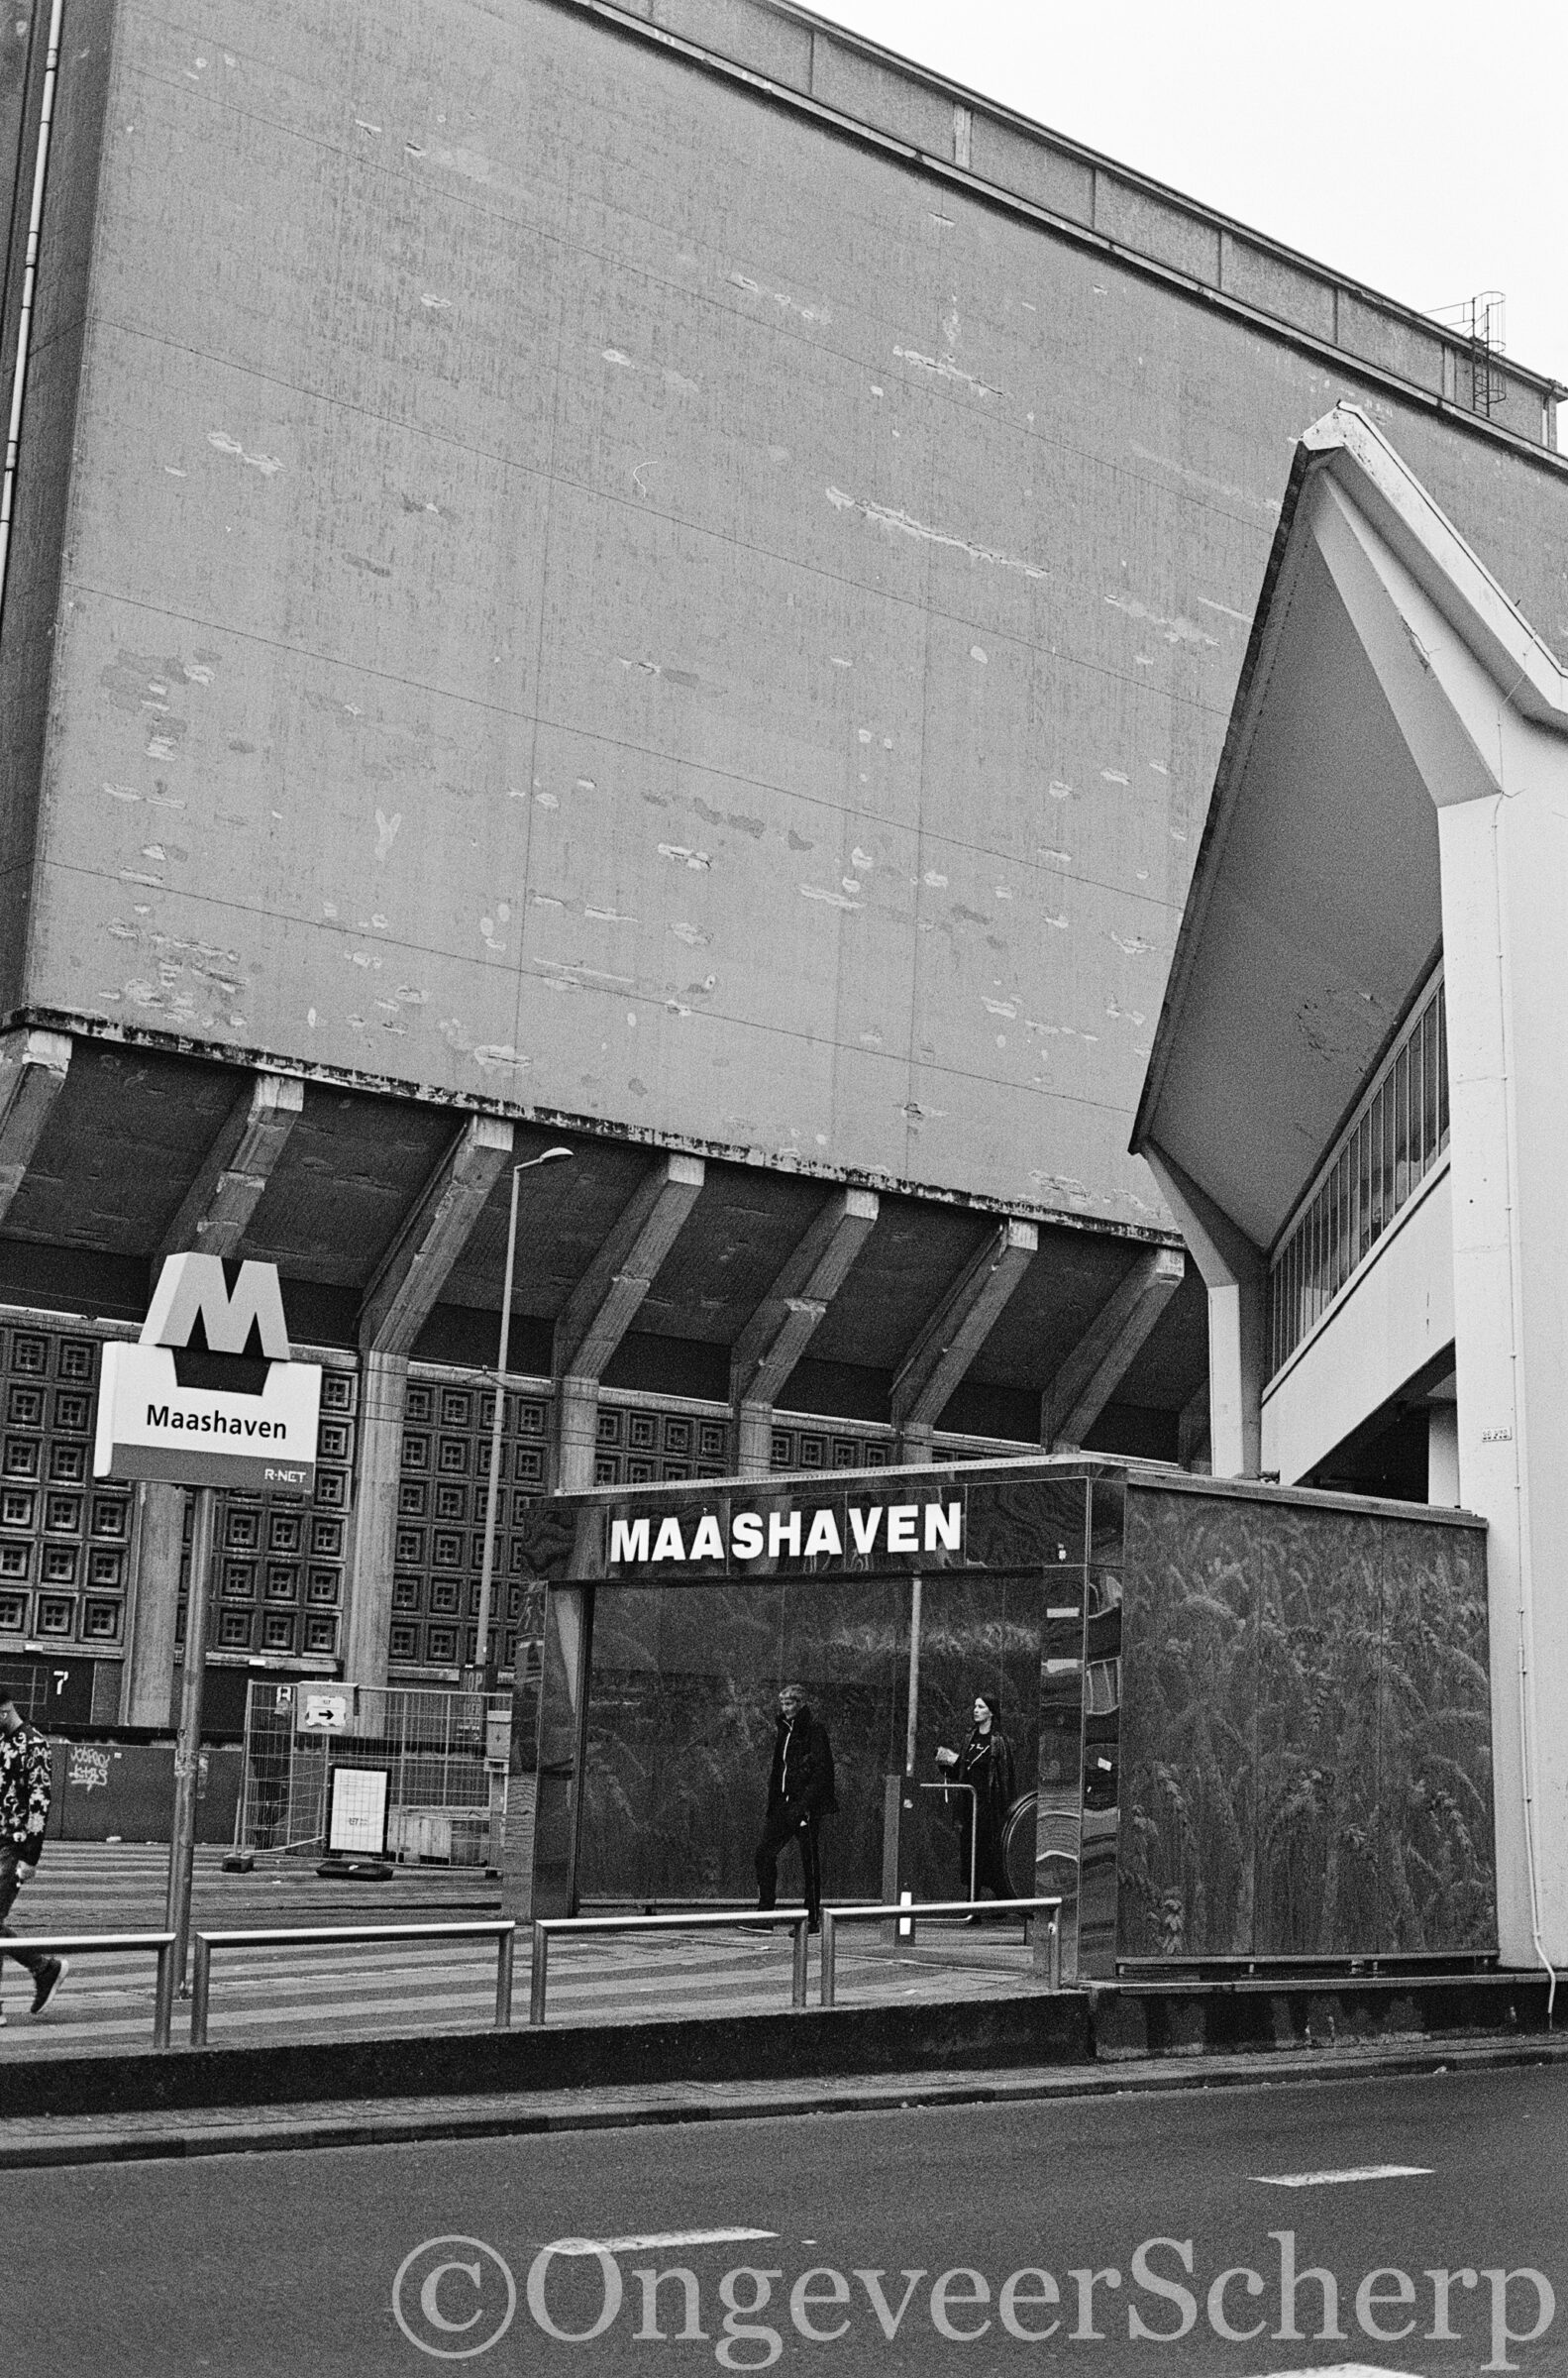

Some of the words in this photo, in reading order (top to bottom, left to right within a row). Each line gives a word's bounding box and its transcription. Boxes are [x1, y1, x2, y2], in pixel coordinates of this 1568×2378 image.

[139, 1251, 291, 1360] M
[147, 1404, 286, 1440] Maashaven
[609, 1501, 963, 1563] MAASHAVEN
[53, 1670, 69, 1695] 7
